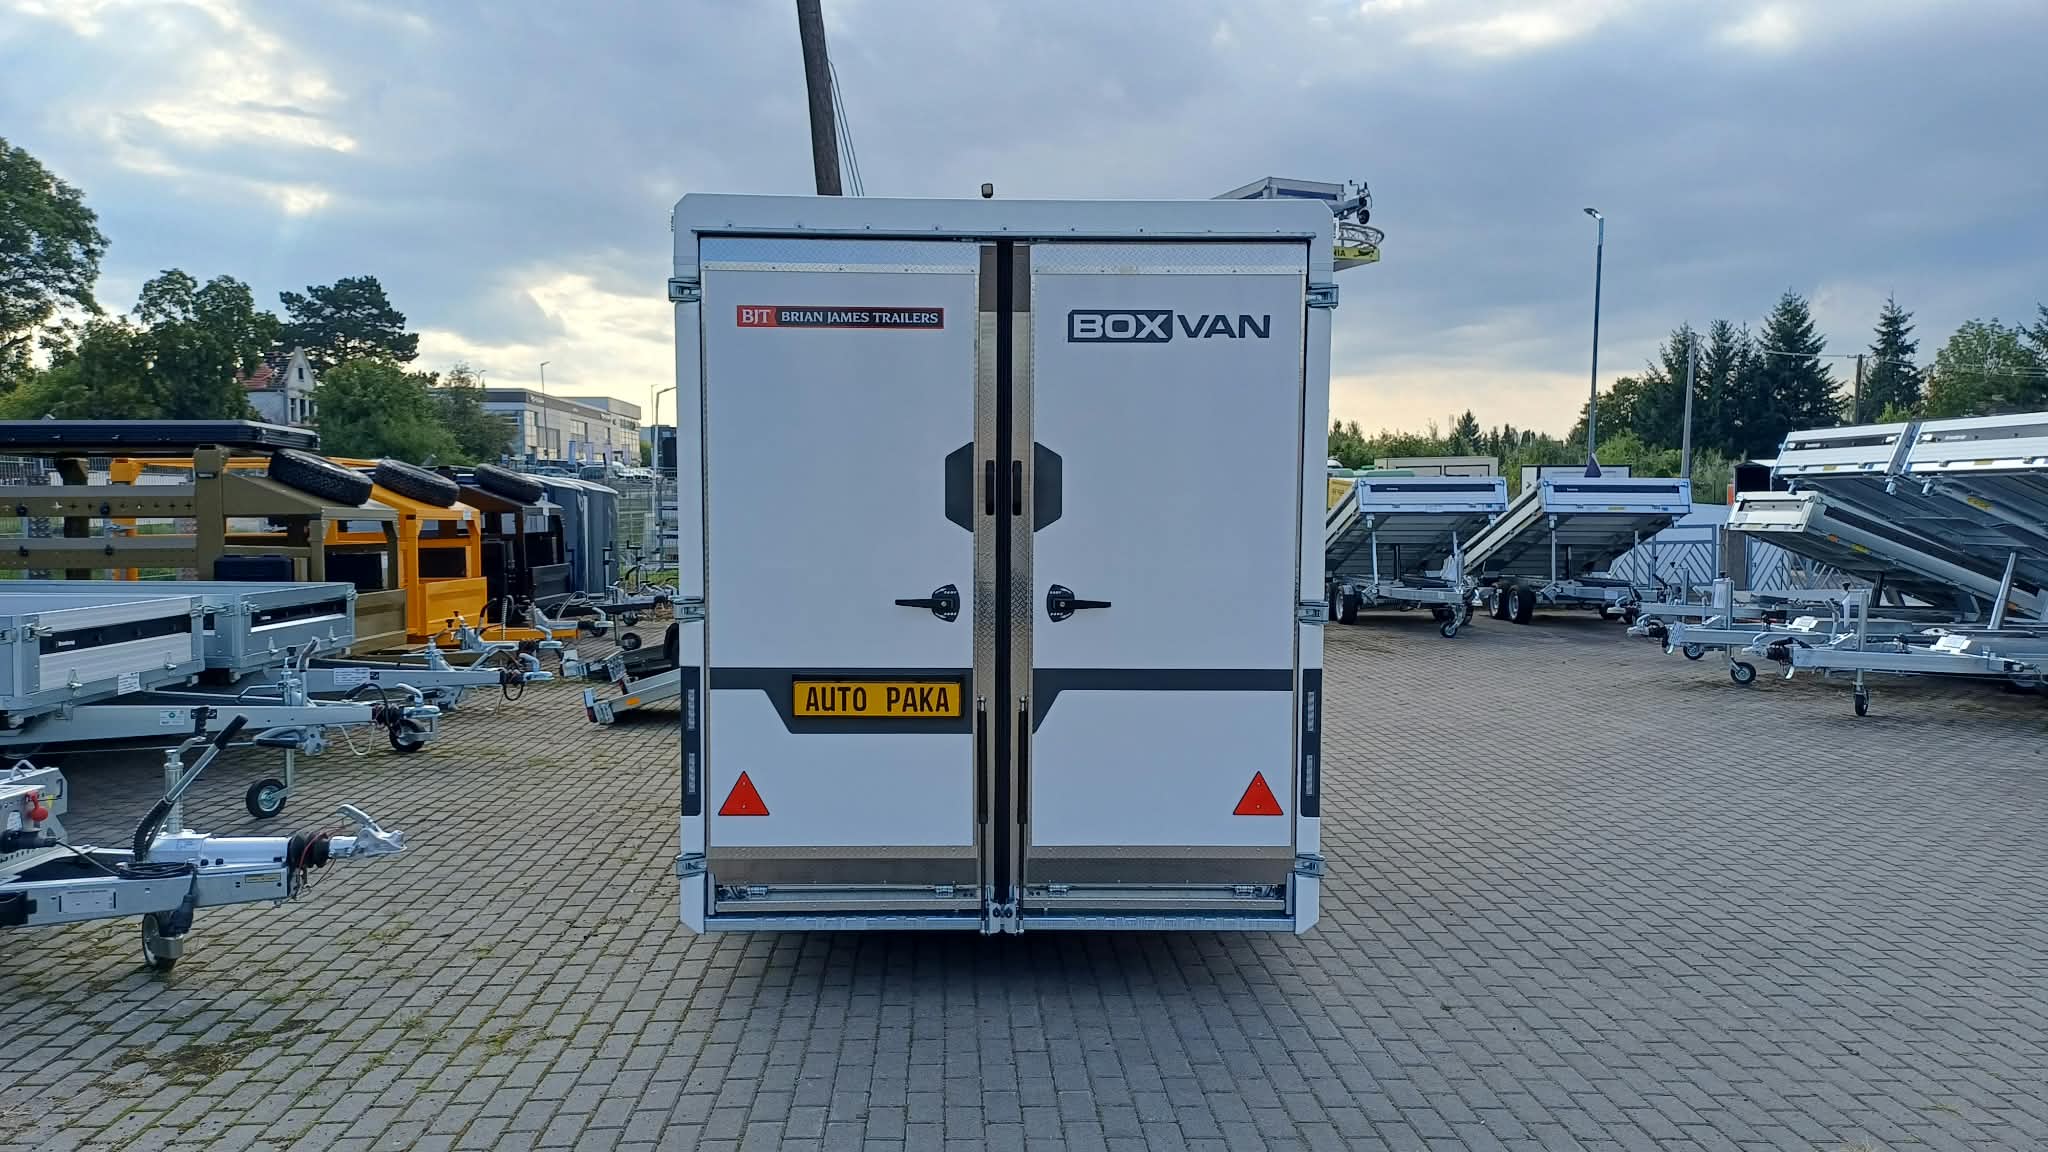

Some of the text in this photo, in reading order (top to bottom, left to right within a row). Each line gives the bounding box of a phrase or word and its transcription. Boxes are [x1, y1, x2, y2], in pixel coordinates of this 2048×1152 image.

[741, 308, 771, 324] BJT
[781, 311, 938, 324] BRIAN JAMES TRAILERS
[805, 686, 950, 713] AUTO PAKA
